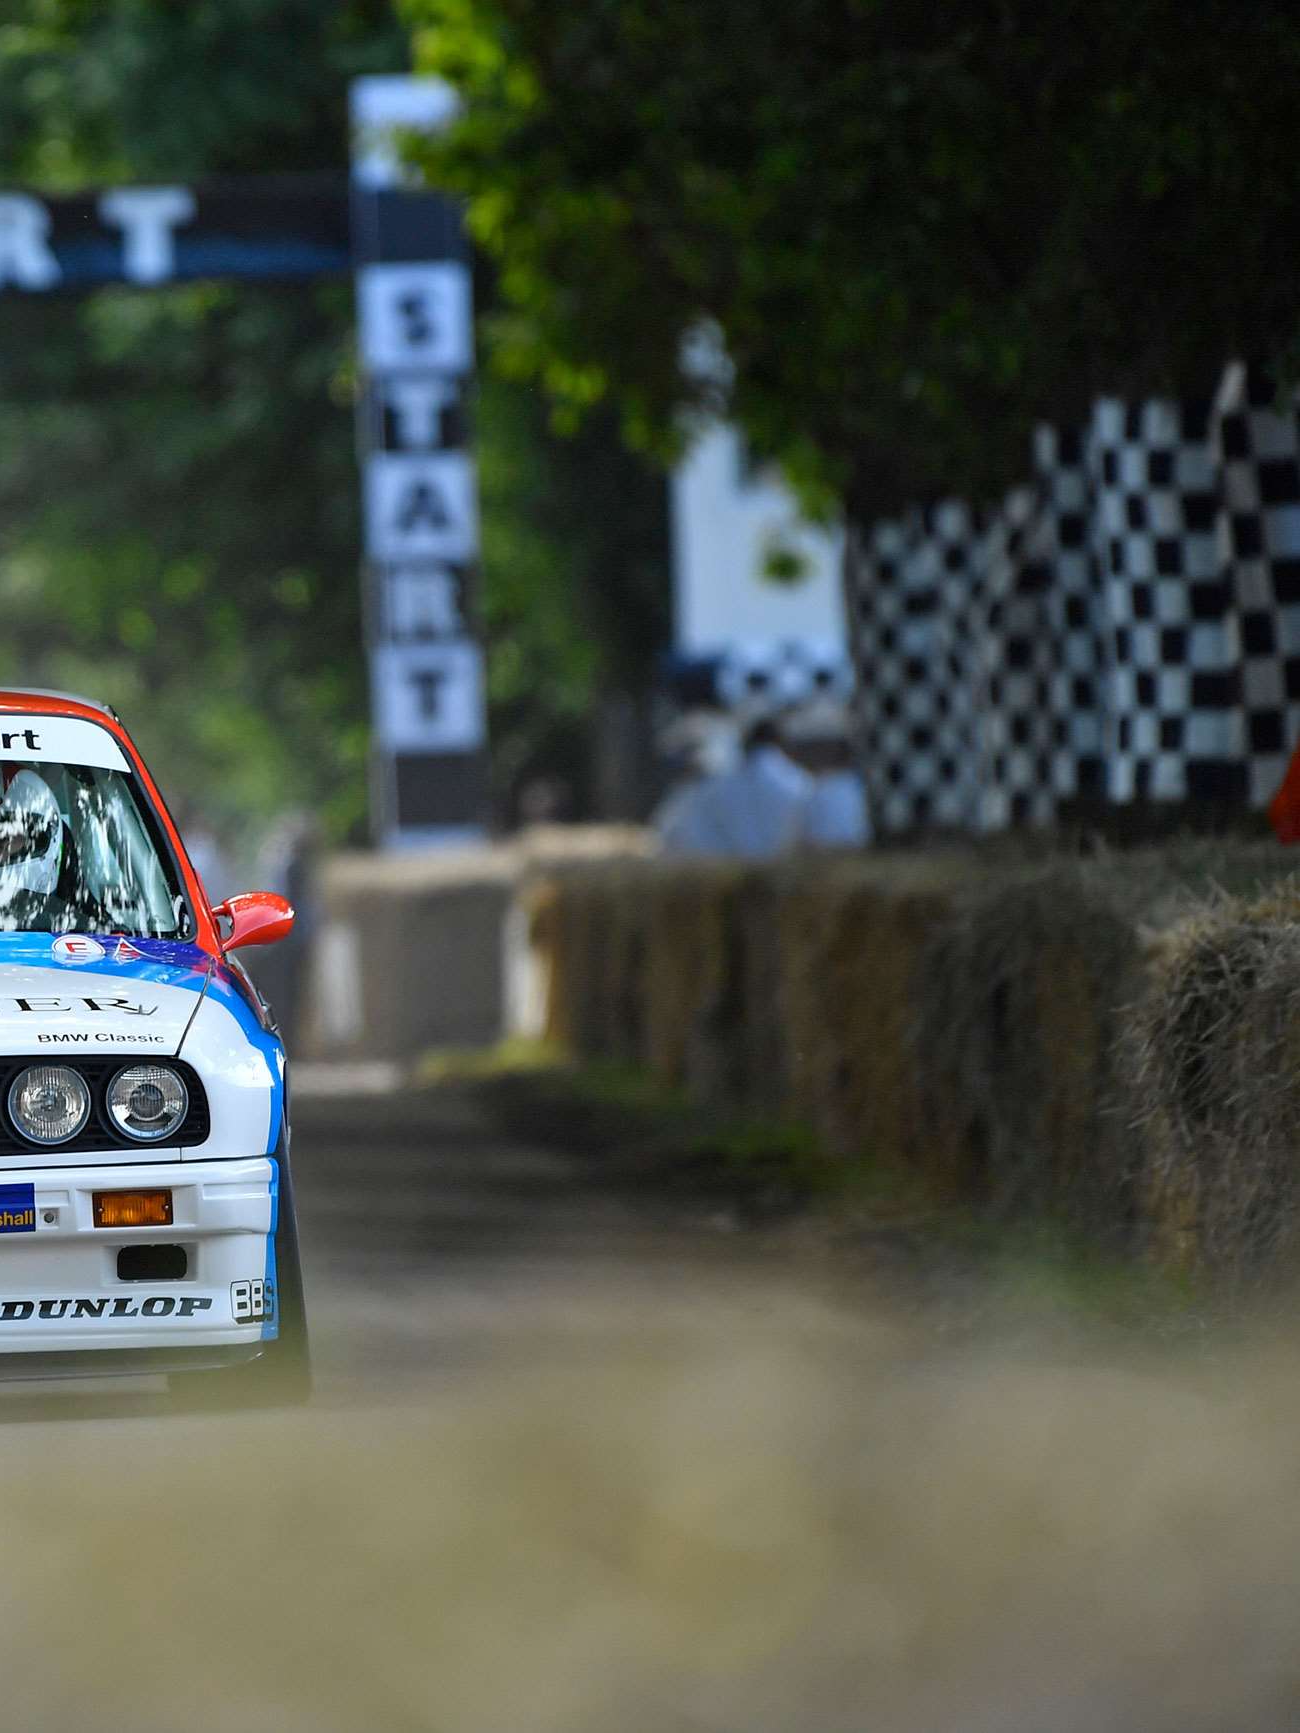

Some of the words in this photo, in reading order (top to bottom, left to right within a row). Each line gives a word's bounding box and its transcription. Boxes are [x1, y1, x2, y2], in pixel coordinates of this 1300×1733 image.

[387, 290, 464, 720] START
[37, 1033, 89, 1043] BMW
[94, 1032, 165, 1043] Classic
